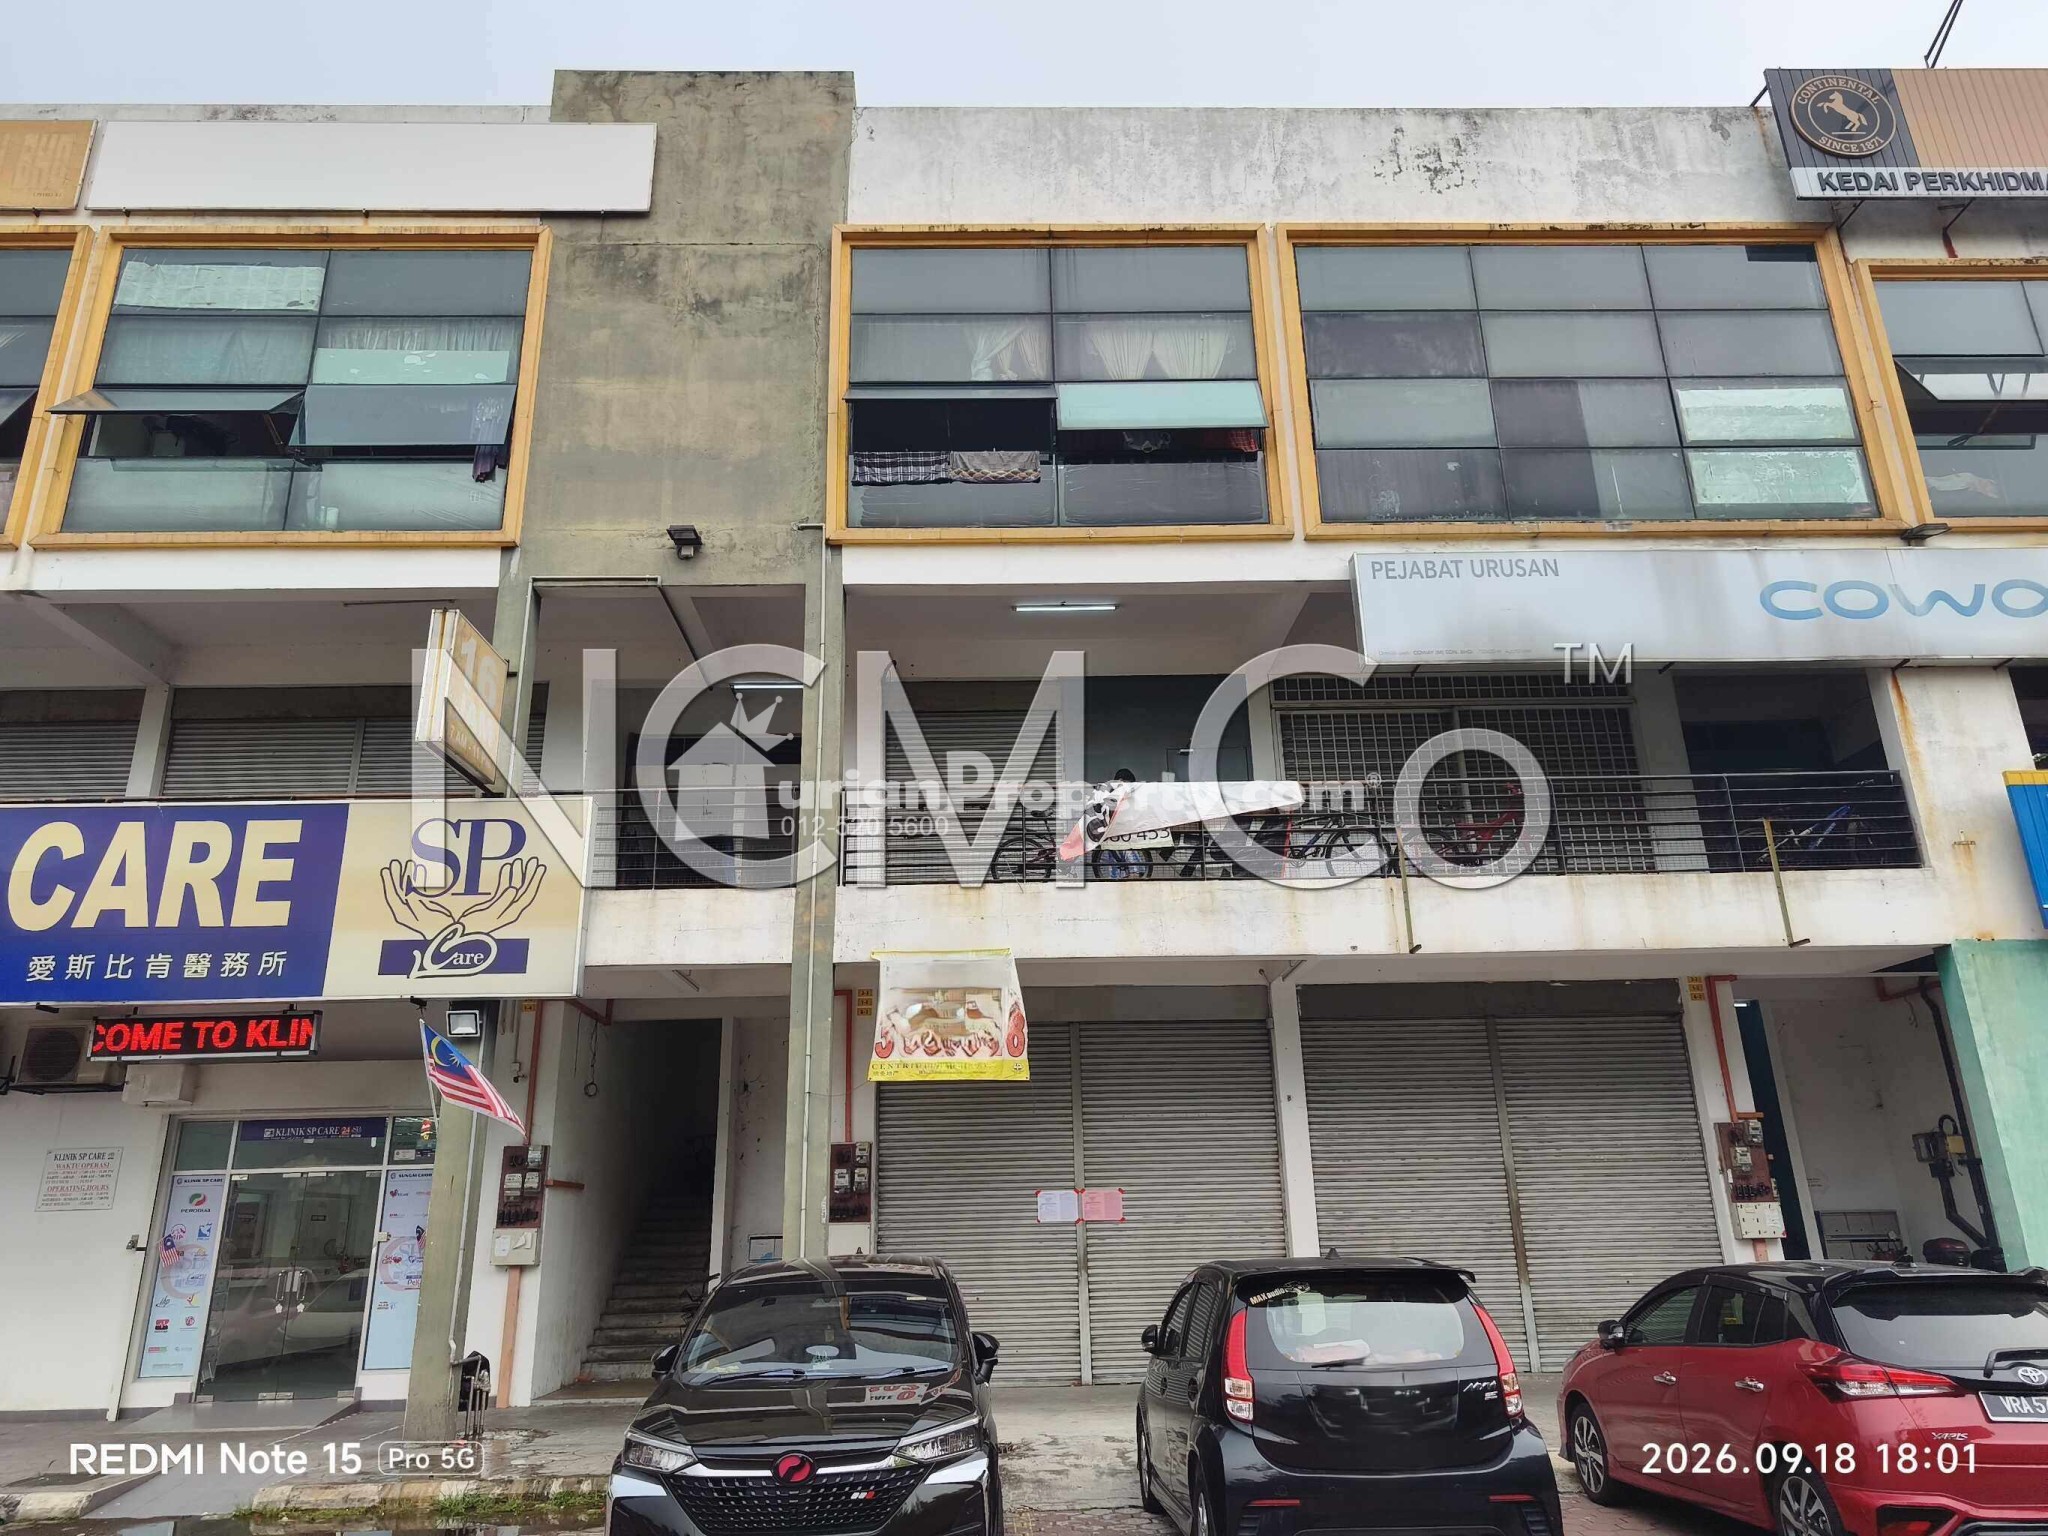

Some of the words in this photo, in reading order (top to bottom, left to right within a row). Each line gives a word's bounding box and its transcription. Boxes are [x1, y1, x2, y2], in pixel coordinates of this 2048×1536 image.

[1797, 77, 1880, 105] CONTINENTAL
[1819, 135, 1859, 153] SINCE
[1859, 136, 1885, 152] 1871
[1817, 172, 1899, 191] KEDAI
[1904, 172, 2048, 191] PERKHIDM
[1371, 560, 1463, 580] PEJABAT
[1470, 558, 1560, 578] URUSAN
[405, 818, 526, 898] SP
[7, 820, 303, 932] CARE
[26, 951, 288, 982] 愛斯比肯醫務所
[192, 1020, 237, 1048] TO
[275, 1127, 306, 1137] KLINIK
[307, 1127, 316, 1136] SP
[318, 1126, 340, 1136] CARE
[54, 1153, 78, 1161] KLINIK
[79, 1153, 88, 1161] SP
[89, 1152, 106, 1160] CARE
[1249, 1292, 1268, 1305] MAX
[1998, 1396, 2034, 1414] VRA
[2031, 1396, 2048, 1414] 5
